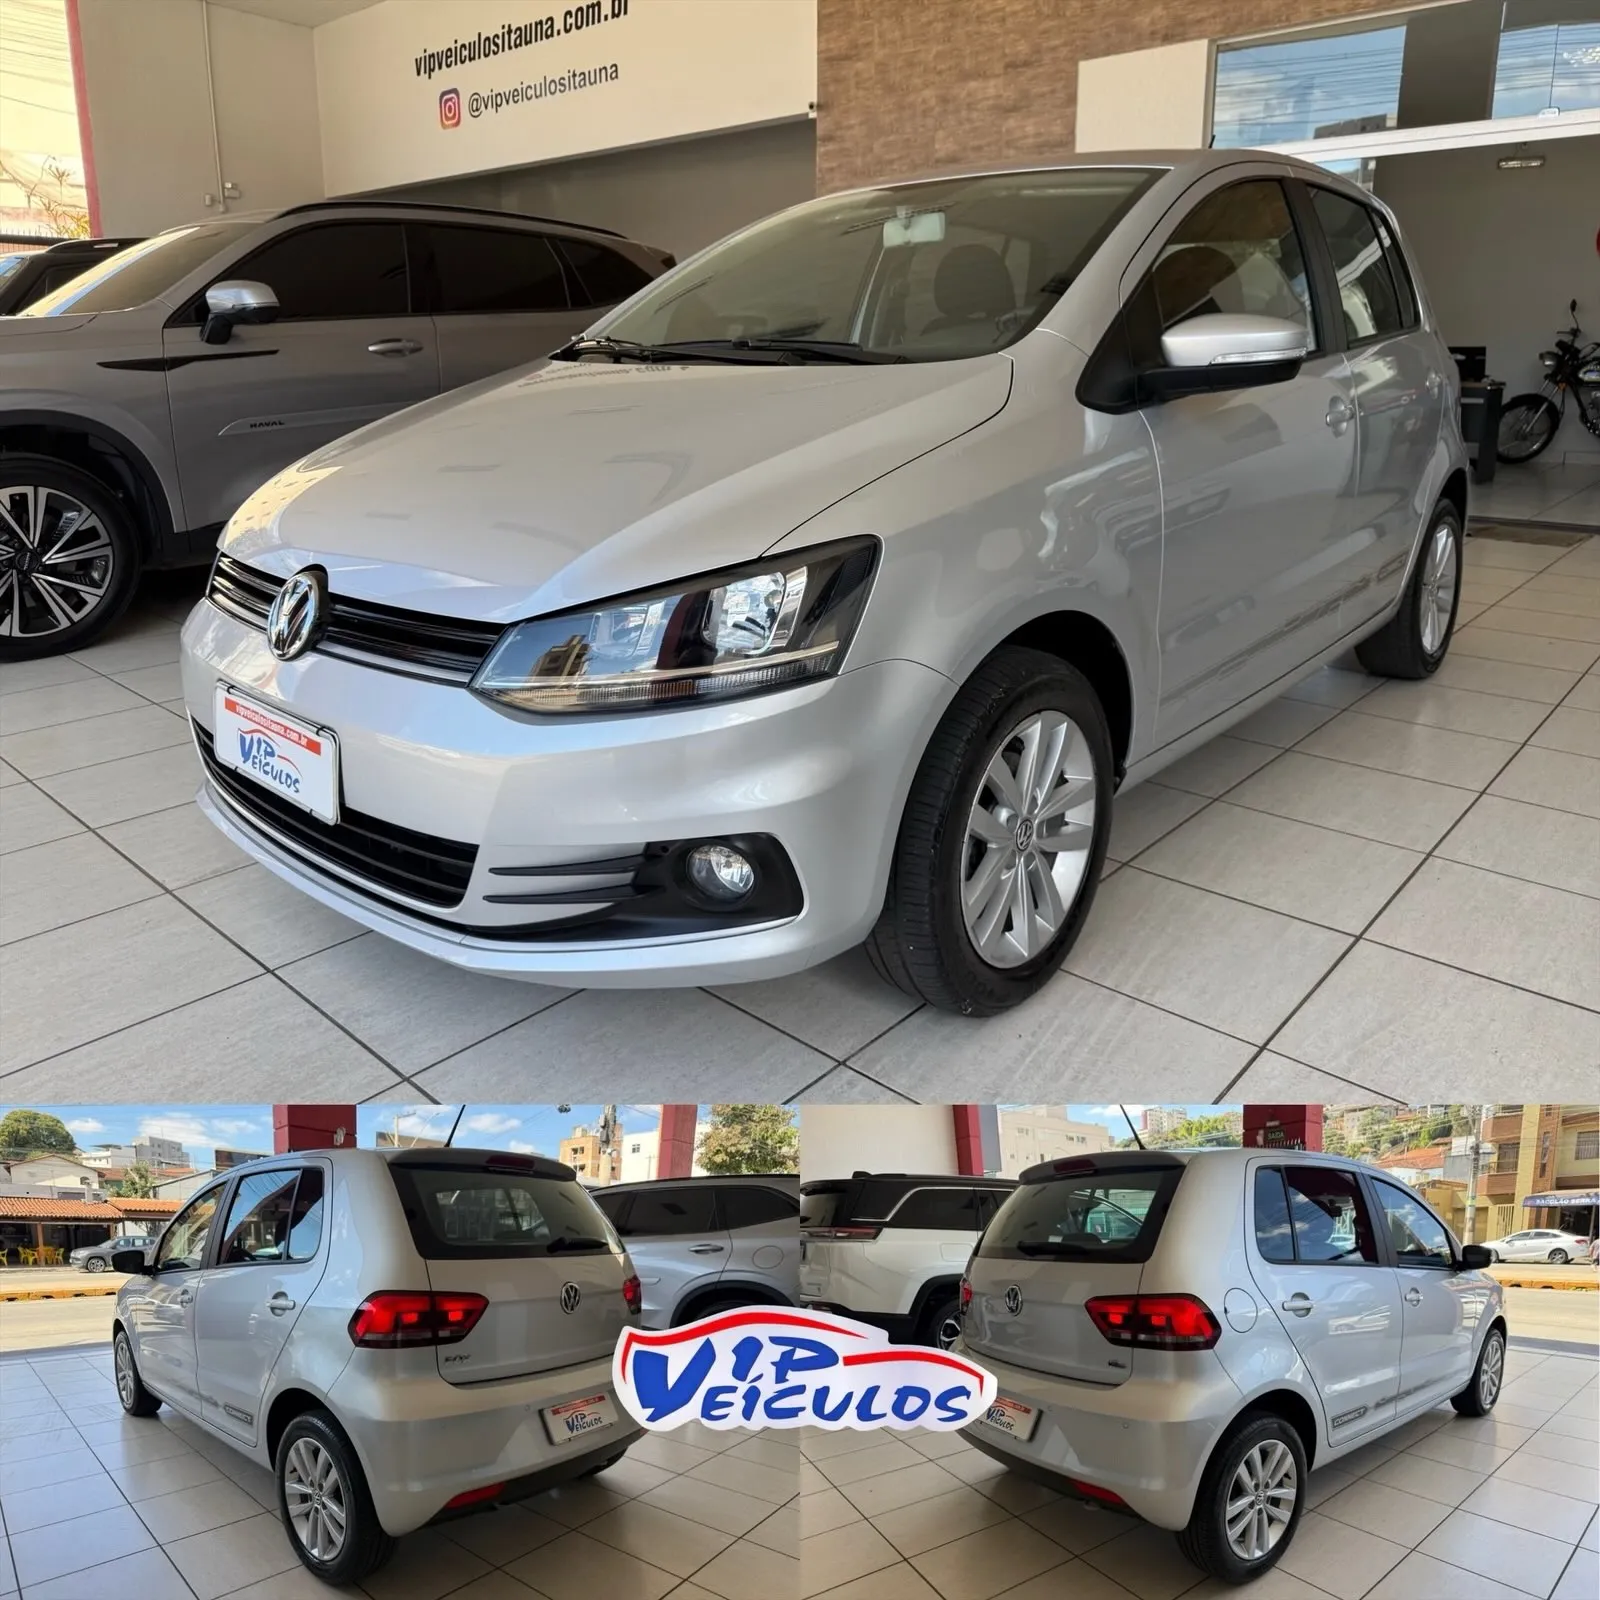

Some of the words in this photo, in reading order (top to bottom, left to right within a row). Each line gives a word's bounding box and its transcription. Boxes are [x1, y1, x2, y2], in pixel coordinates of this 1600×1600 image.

[415, 0, 629, 80] vipveiculositauna.com.br
[468, 63, 619, 118] @vipveiculositauna
[250, 420, 285, 428] HAVAL
[239, 733, 276, 764] VIP
[566, 1413, 587, 1434] VIP
